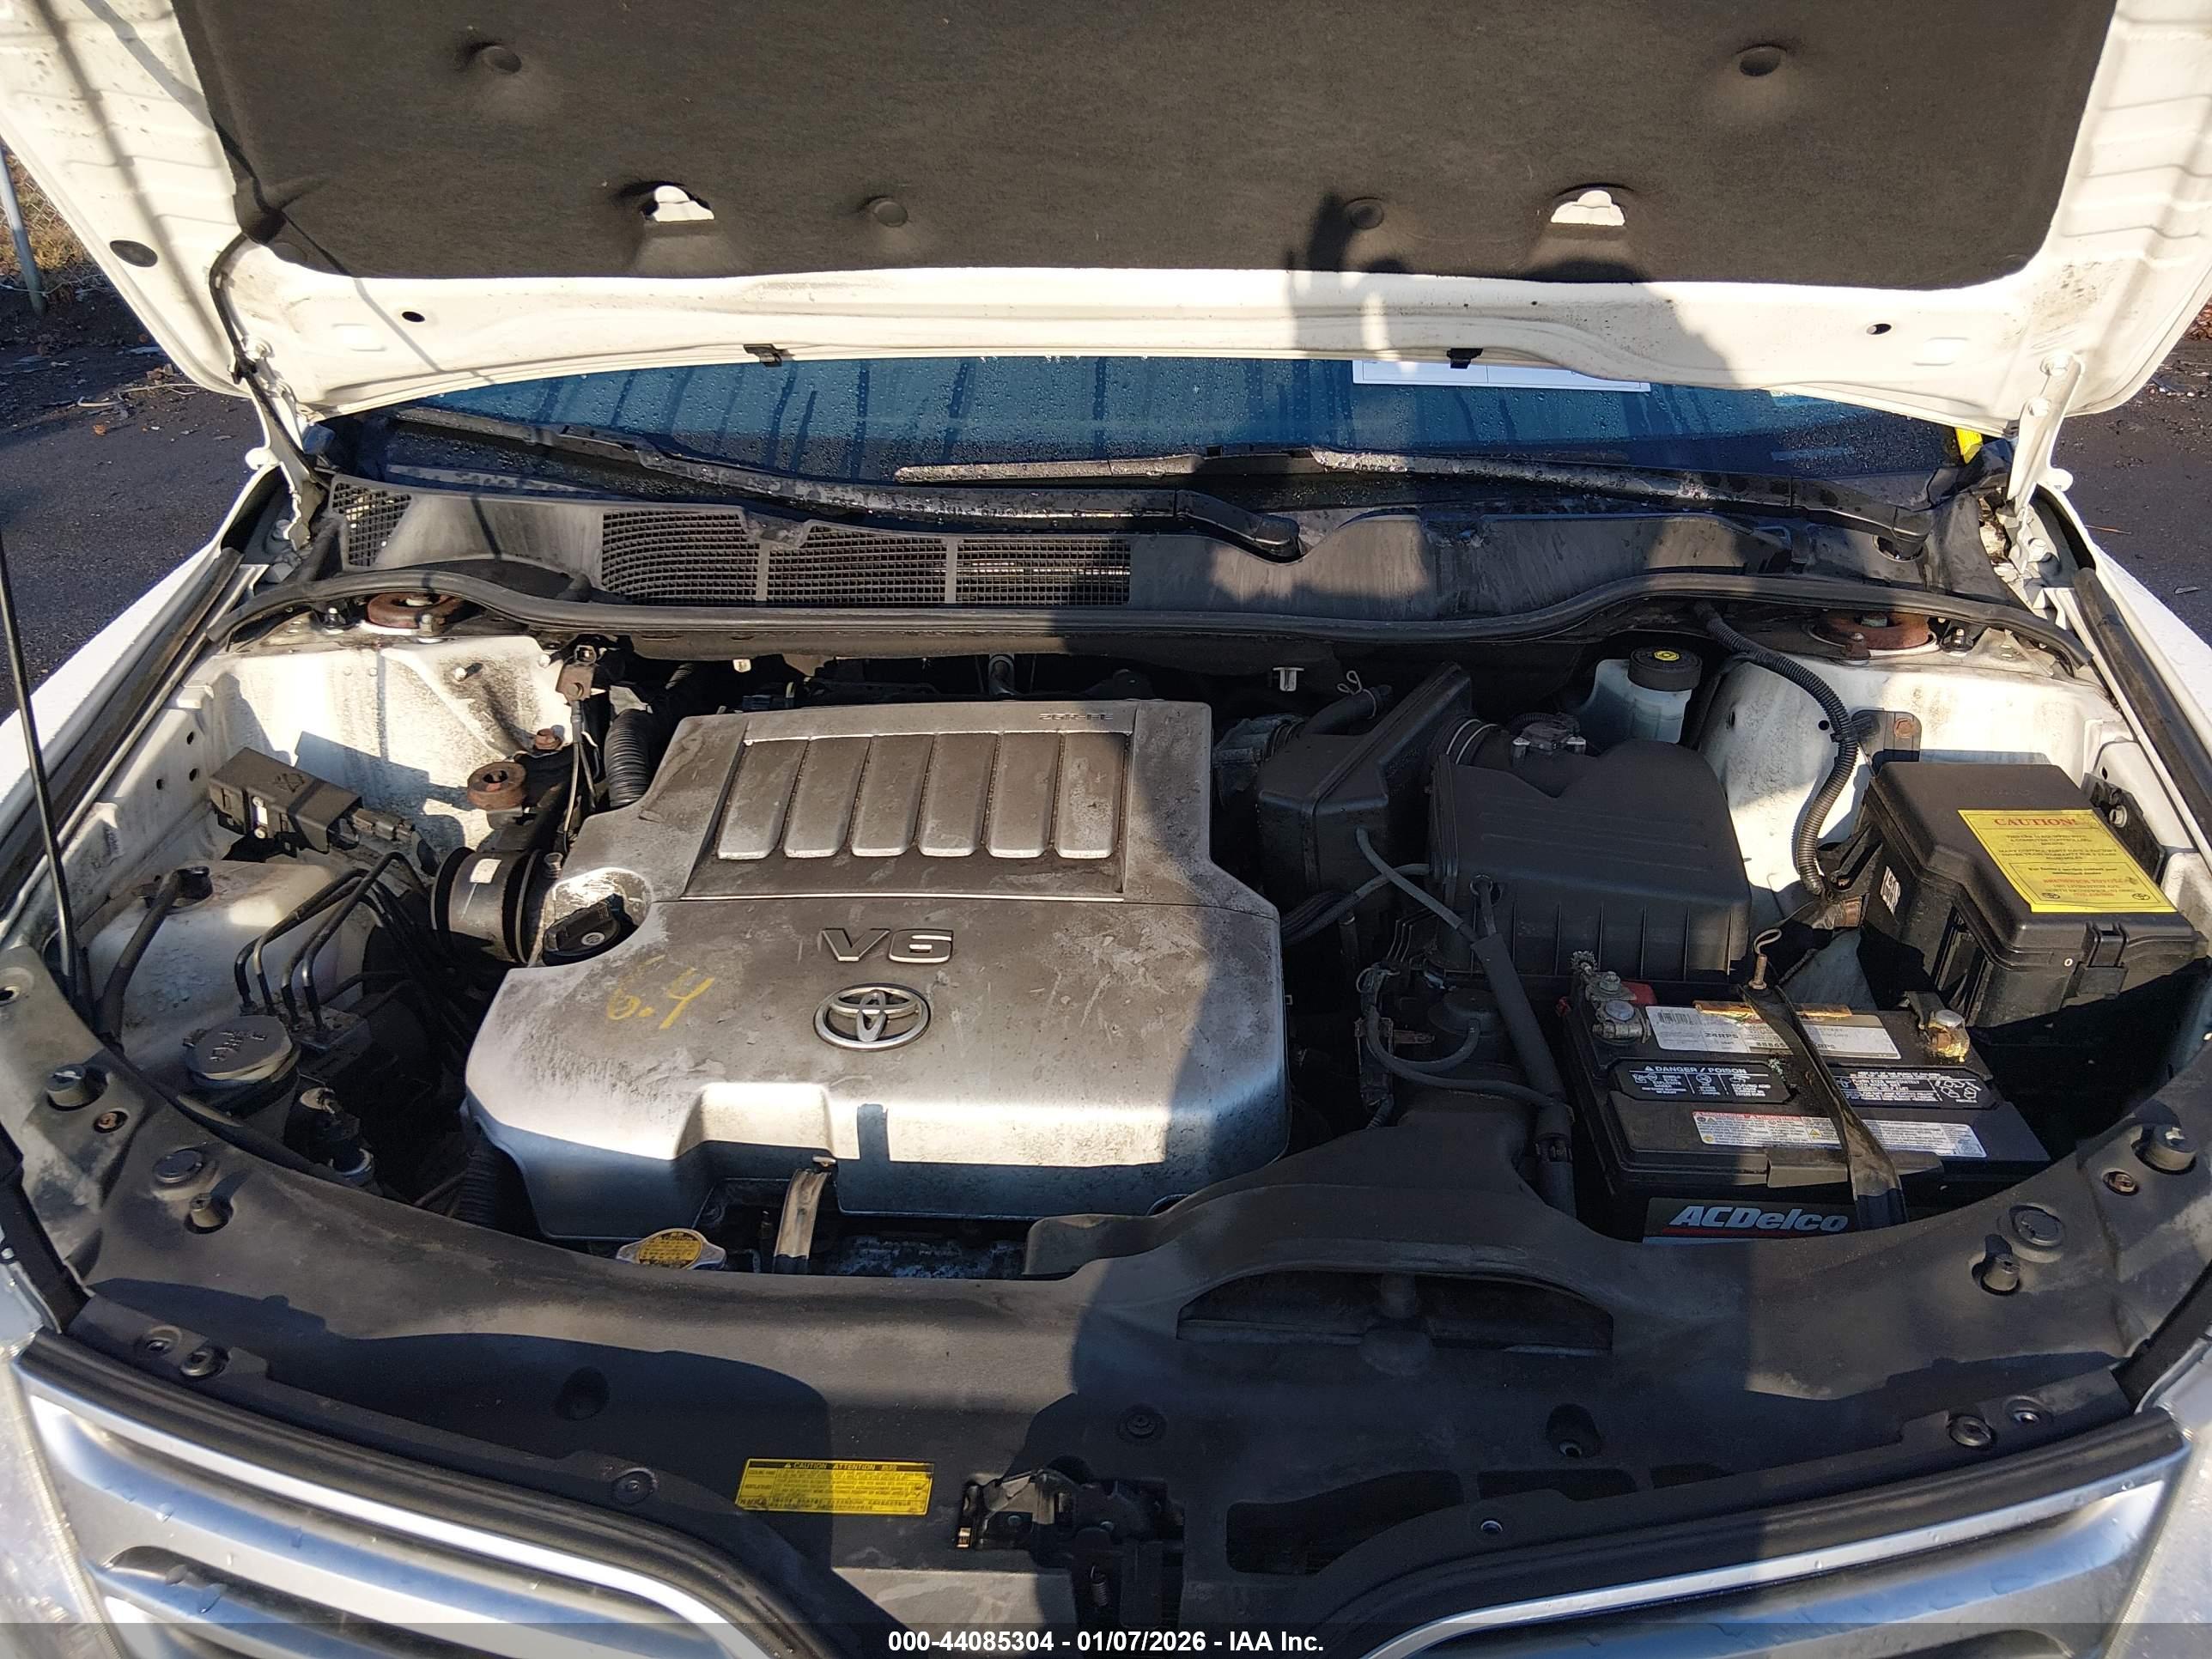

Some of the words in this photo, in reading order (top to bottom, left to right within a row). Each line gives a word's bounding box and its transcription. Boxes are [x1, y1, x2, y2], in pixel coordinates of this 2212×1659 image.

[1994, 817, 2078, 826] CAUTION!
[820, 927, 955, 963] V6
[1668, 1205, 1850, 1232] ACDelco
